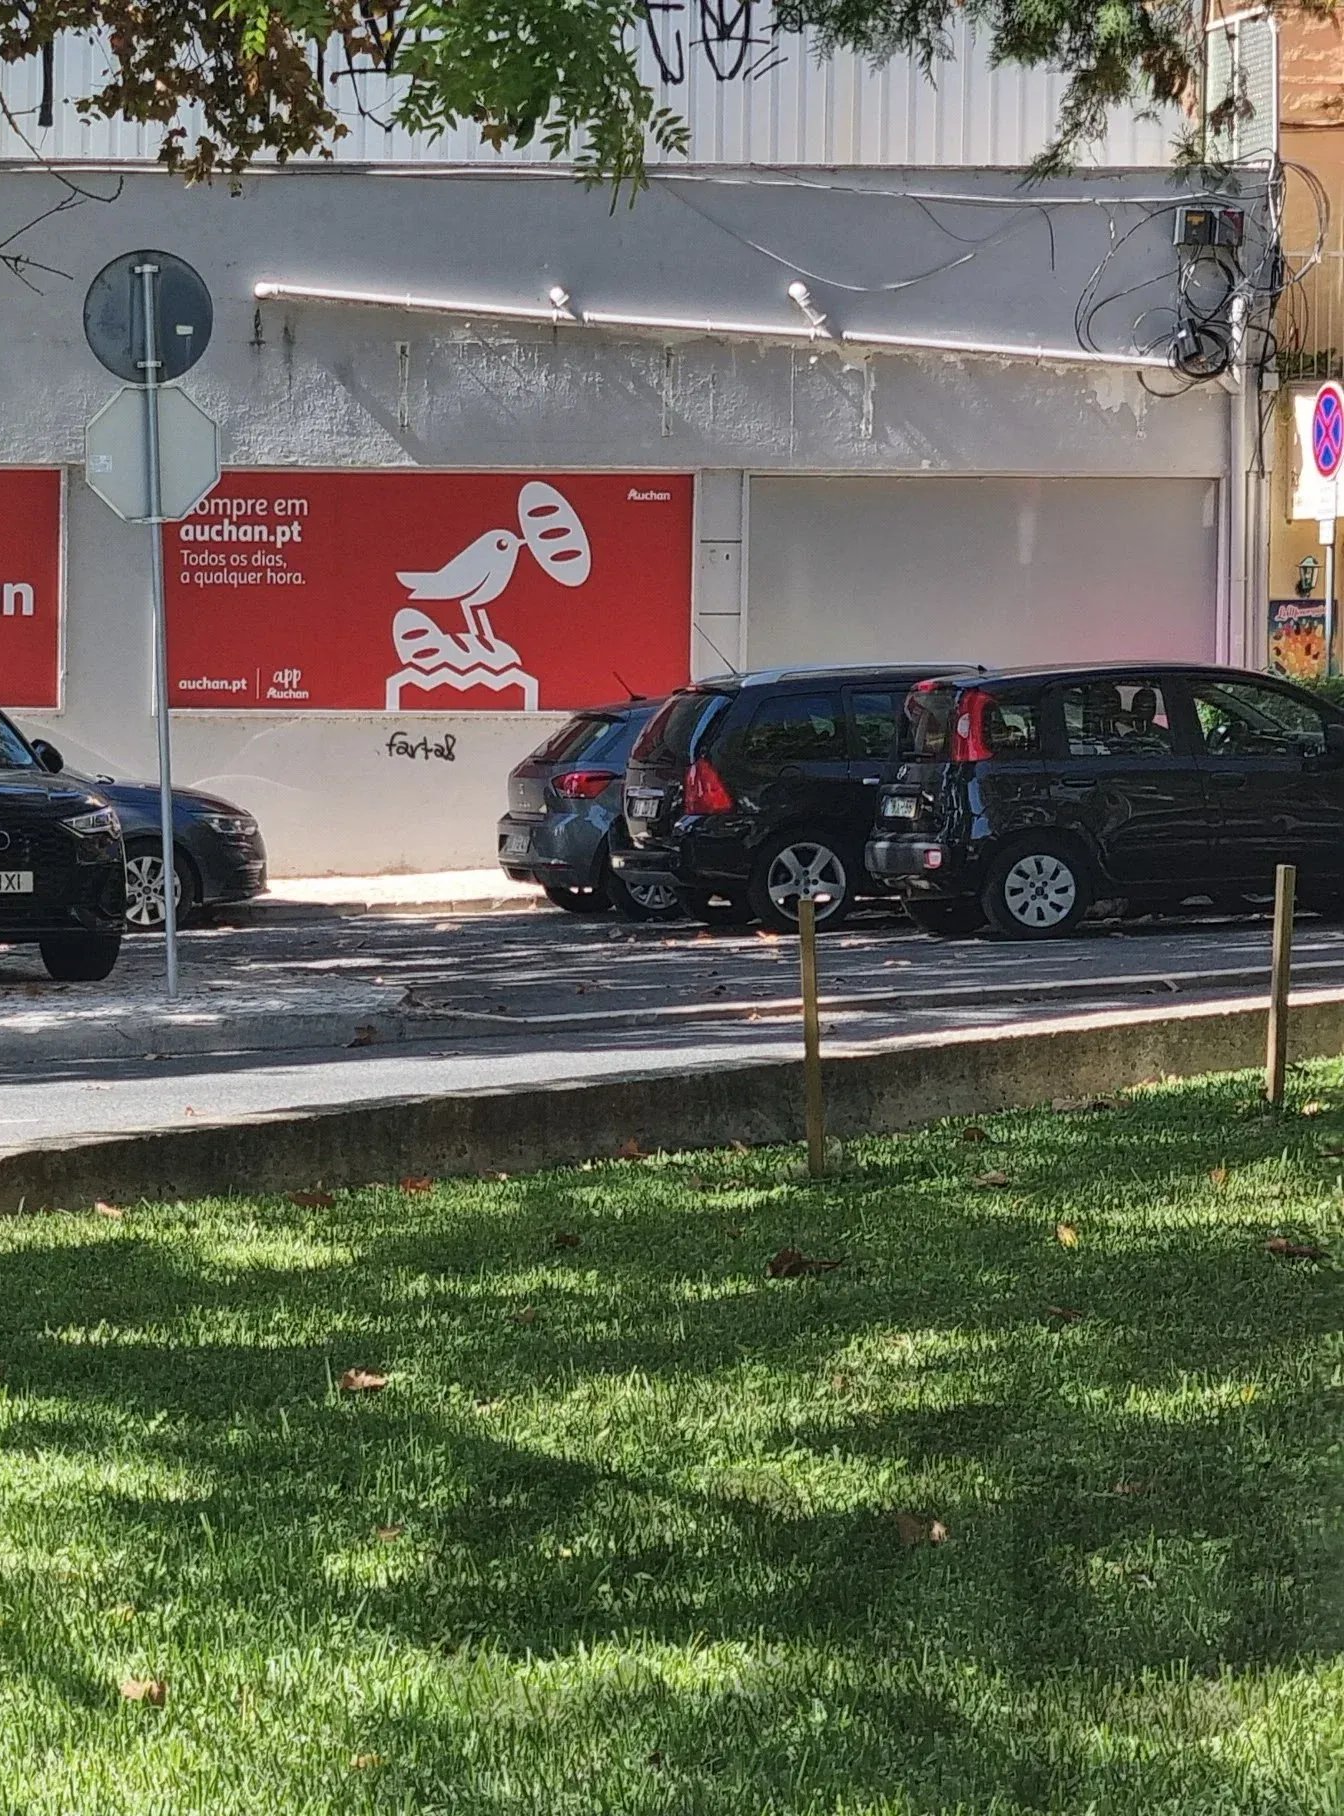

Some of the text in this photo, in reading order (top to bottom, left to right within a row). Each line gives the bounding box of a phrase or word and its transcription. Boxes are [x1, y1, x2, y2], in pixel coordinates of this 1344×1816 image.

[627, 488, 672, 501] Auchan
[192, 498, 309, 522] ompre em
[179, 518, 303, 549] auchan.pt
[180, 549, 288, 569] Todos os dias,
[180, 568, 306, 588] a qualquer hora.
[178, 676, 248, 693] auchan.pt
[273, 668, 302, 689] app
[266, 687, 310, 699] Auchan
